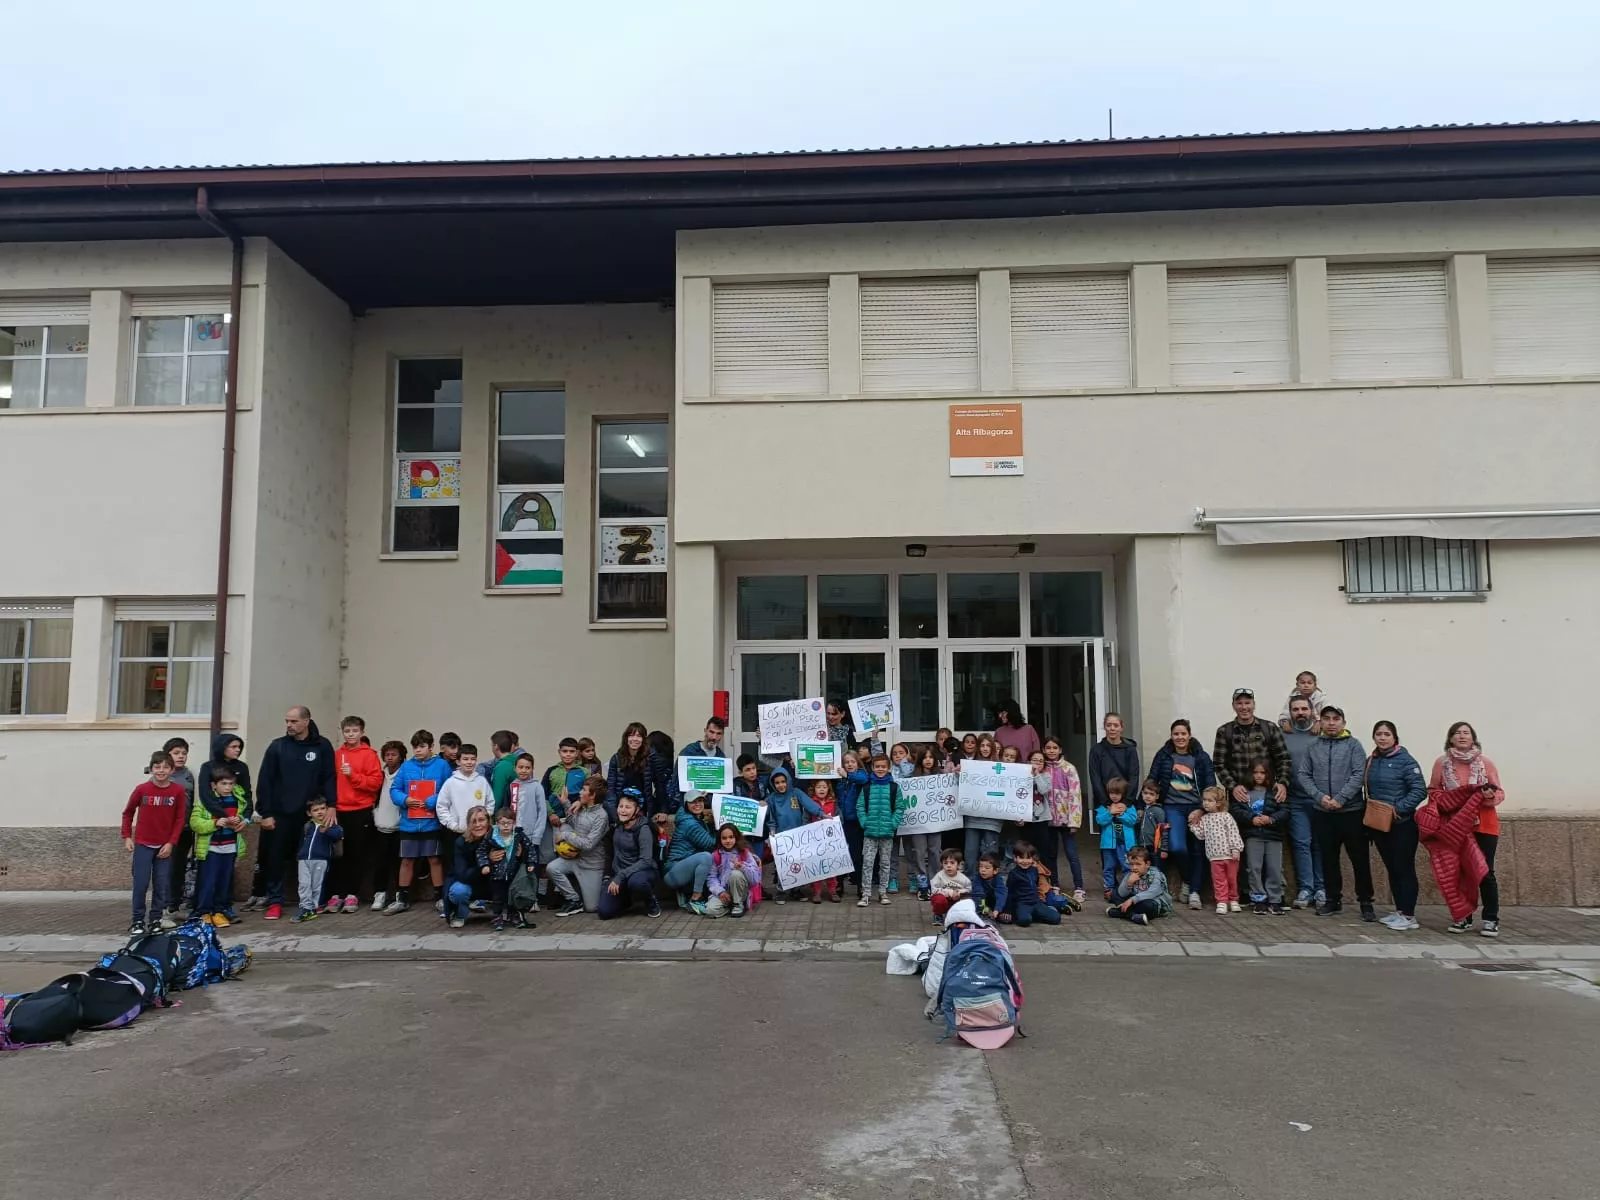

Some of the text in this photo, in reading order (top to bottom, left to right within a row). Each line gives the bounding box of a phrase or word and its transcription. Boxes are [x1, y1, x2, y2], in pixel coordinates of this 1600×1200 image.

[955, 428, 1014, 437] Alta Ribagorza
[410, 460, 440, 499] P
[502, 491, 556, 531] A
[762, 705, 779, 721] LOS
[799, 714, 821, 723] PERO
[762, 740, 785, 751] NO SE
[900, 773, 959, 791] UCACIÓN
[925, 791, 945, 806] SE
[960, 797, 1029, 814] FUTURO
